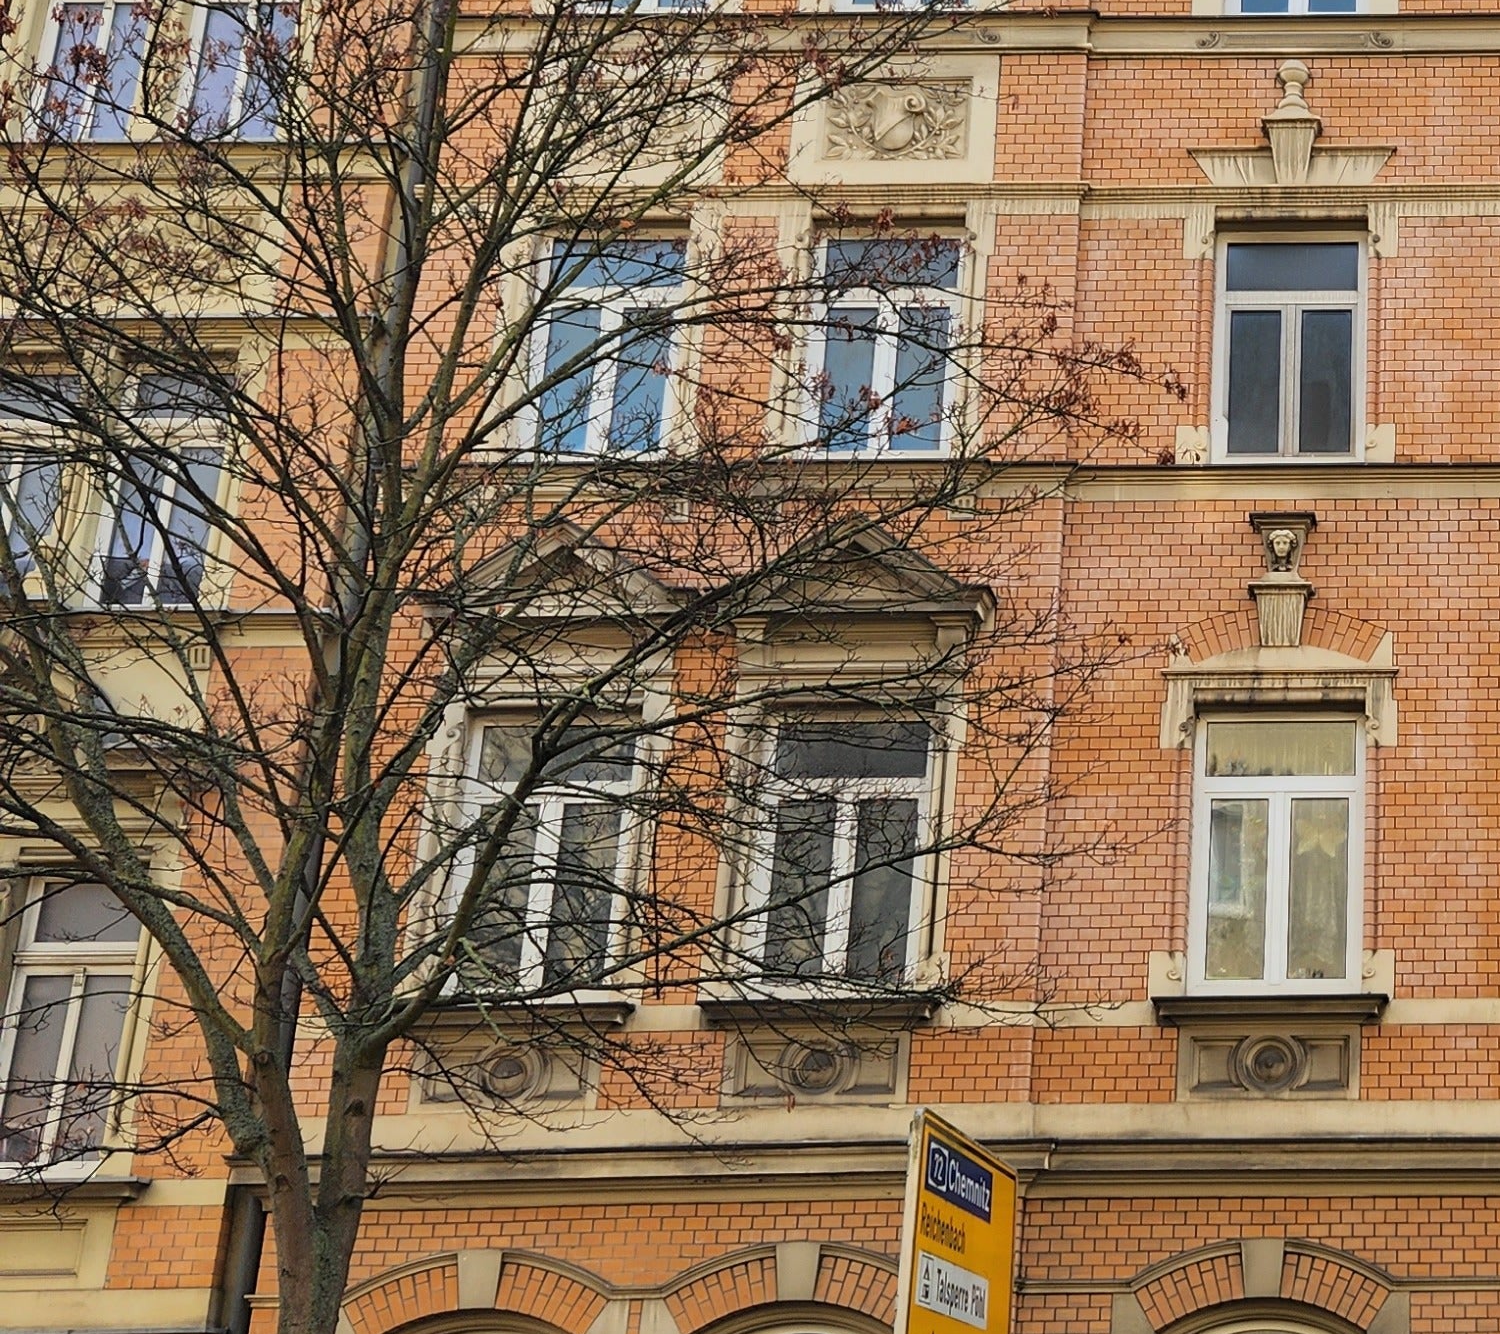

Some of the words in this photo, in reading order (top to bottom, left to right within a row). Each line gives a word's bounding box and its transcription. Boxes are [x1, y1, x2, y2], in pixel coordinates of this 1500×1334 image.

[934, 1153, 944, 1181] 72
[948, 1158, 991, 1213] Chemnitz
[920, 1202, 965, 1254] Reichenbach
[936, 1268, 969, 1316] Talsperre
